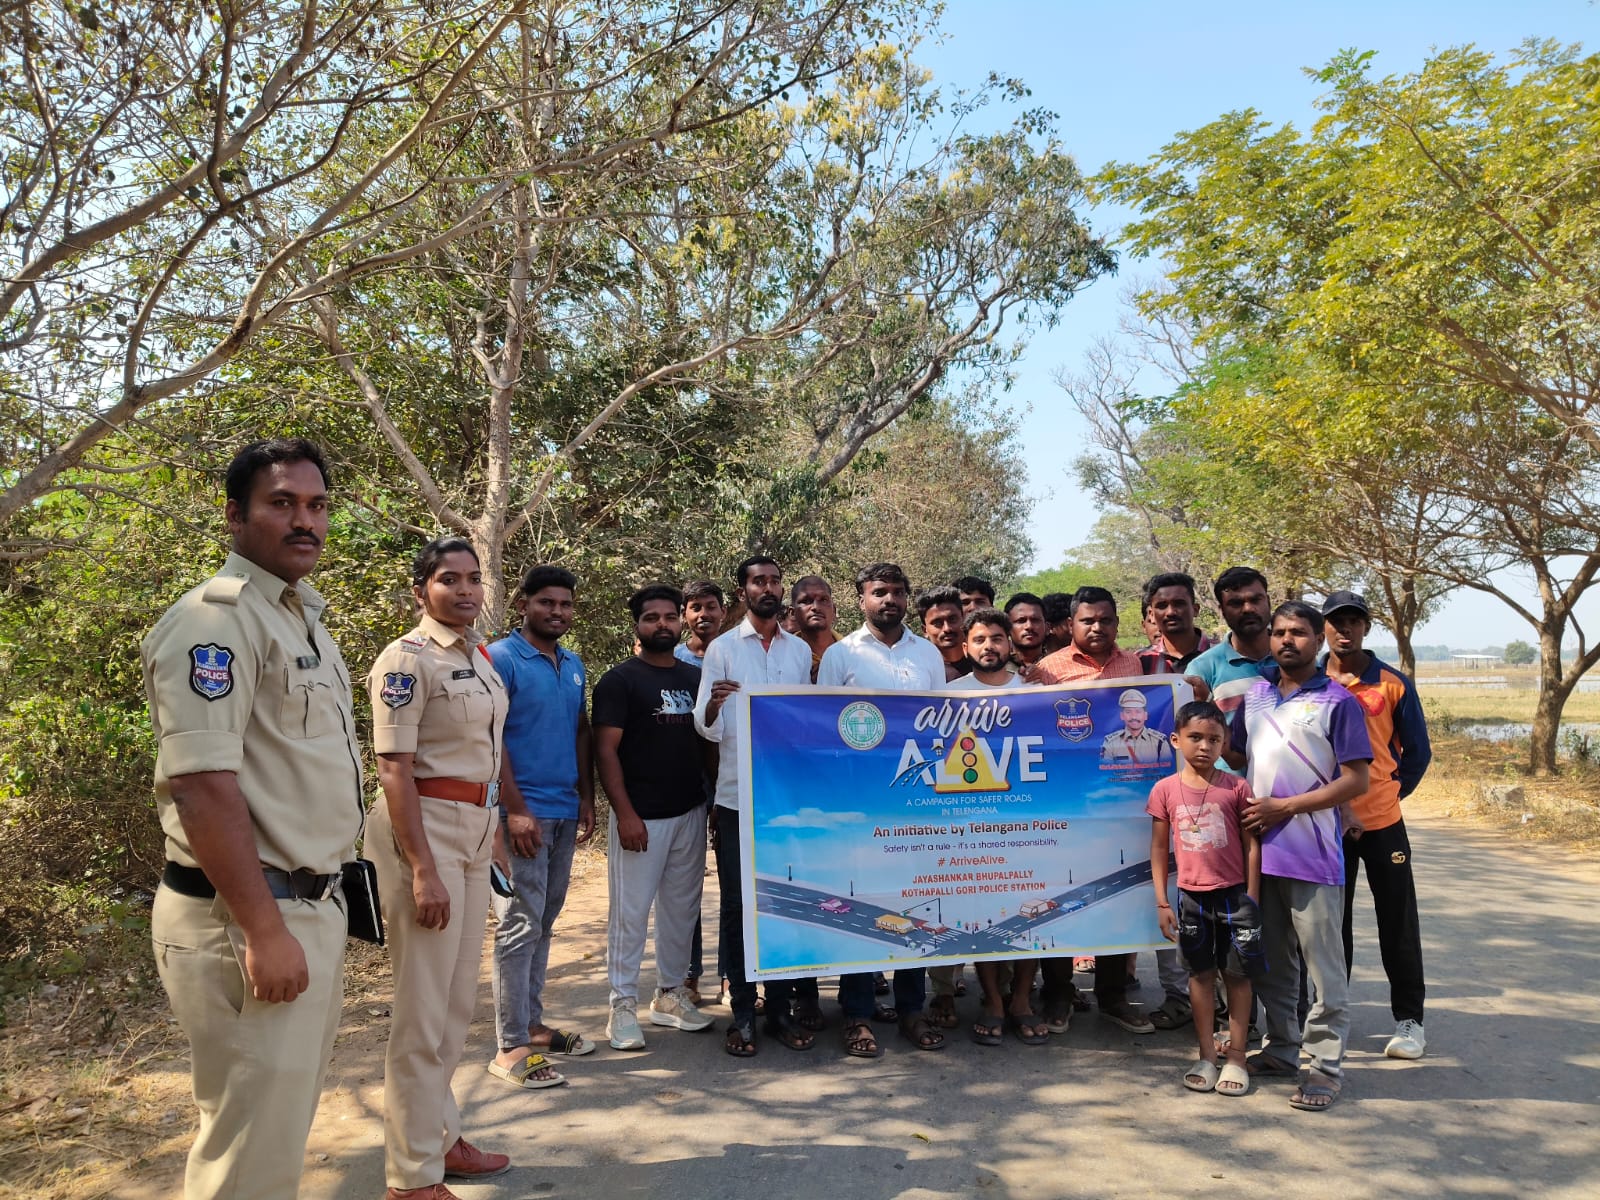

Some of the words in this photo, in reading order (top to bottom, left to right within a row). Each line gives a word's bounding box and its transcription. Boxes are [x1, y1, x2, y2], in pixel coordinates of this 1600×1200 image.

[195, 667, 229, 680] POLICE
[913, 698, 1012, 738] arrive
[1059, 718, 1090, 727] POLICE
[906, 799, 912, 807] A
[914, 797, 959, 807] CAMPAIGN
[960, 796, 977, 804] FOR
[979, 795, 1002, 804] SAFER
[1004, 793, 1032, 803] ROADS
[941, 808, 950, 816] IN
[952, 806, 998, 816] TELENGANA
[873, 826, 890, 837] An
[893, 824, 947, 837] initiative
[951, 823, 965, 836] by
[968, 822, 1029, 835] Telangana
[1032, 819, 1068, 831] Police
[883, 844, 908, 853] Safety
[910, 843, 925, 851] isn't
[935, 843, 951, 851] rule
[958, 841, 969, 849] it's
[978, 841, 1006, 849] shared
[937, 857, 946, 867] #
[949, 855, 1008, 866] ArriveAlive.
[912, 872, 974, 884] JAYASHANKAR
[975, 870, 1034, 881] BHUPALPALLY
[901, 887, 954, 897] KOTHAPALLI
[955, 885, 977, 895] GORI
[978, 884, 1009, 894] POLICE
[1010, 882, 1046, 891] STATION
